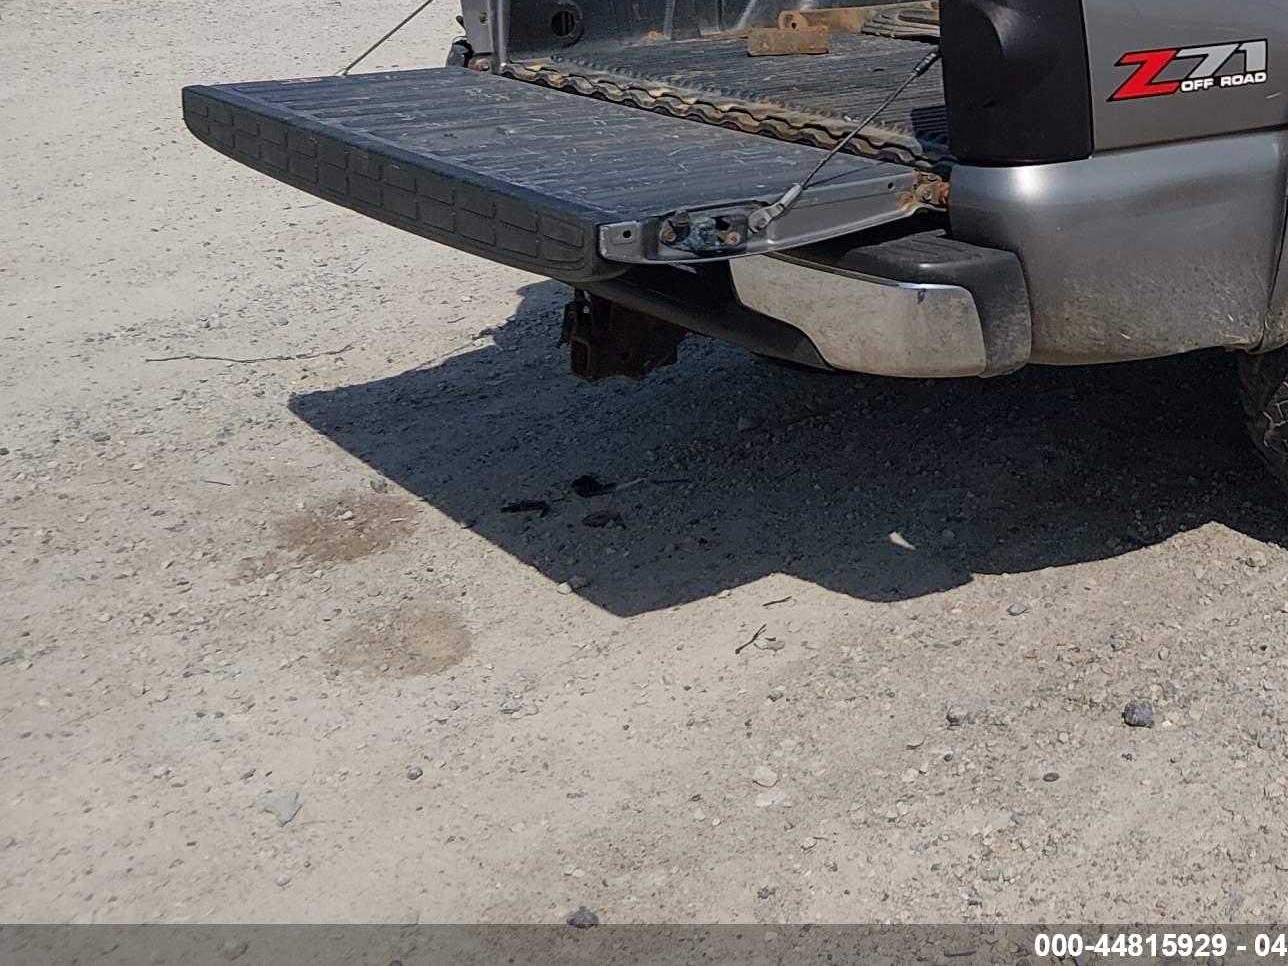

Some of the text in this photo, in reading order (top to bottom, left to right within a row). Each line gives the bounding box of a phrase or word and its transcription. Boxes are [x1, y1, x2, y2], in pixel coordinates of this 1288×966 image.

[1106, 38, 1268, 101] Z71
[1180, 71, 1268, 93] OFF ROAD
